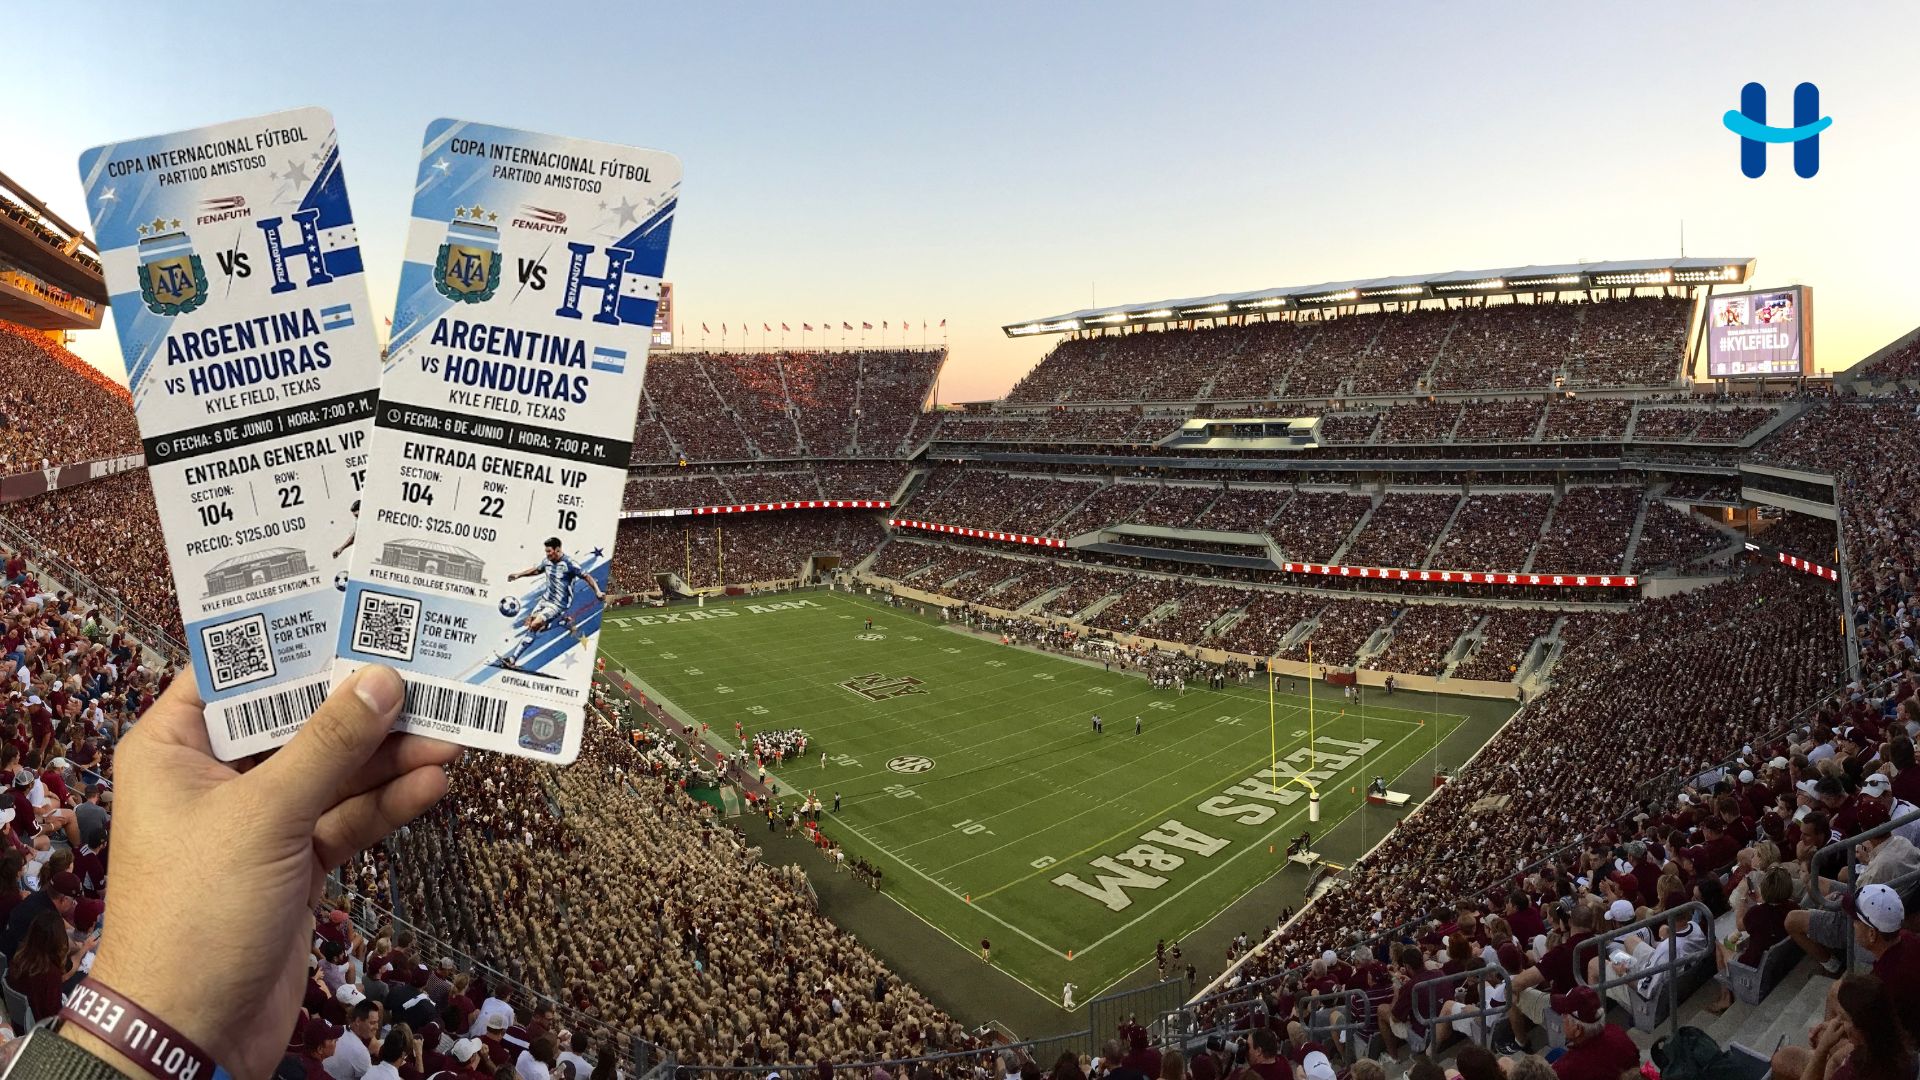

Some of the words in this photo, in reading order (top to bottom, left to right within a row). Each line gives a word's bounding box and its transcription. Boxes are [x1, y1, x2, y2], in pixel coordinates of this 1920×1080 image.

[108, 158, 142, 178] COPA
[148, 138, 253, 170] INTERNACIONAL
[256, 126, 308, 149] FÚTBOL
[451, 138, 486, 158] COPA
[490, 144, 595, 174] INTERNACIONAL
[600, 158, 651, 182] FÚTBOL
[159, 166, 207, 186] PARTIDO
[210, 156, 266, 177] AMISTOSO
[493, 166, 541, 184] PARTIDO
[544, 172, 602, 194] AMISTOSO
[197, 208, 250, 225] FENAFUTH
[512, 219, 568, 234] FENAFUTH
[168, 308, 320, 366] ARGENTINA
[431, 318, 586, 369] ARGENTINA
[1720, 333, 1789, 352] #KYLEFIELD
[164, 377, 185, 396] VS
[189, 341, 331, 396] HONDURAS
[421, 356, 439, 374] VS
[444, 356, 589, 403] HONDURAS
[205, 396, 238, 414] KYLE
[240, 386, 279, 406] FIELD,
[282, 378, 321, 398] TEXAS
[449, 390, 480, 407] KYLE
[484, 396, 521, 416] FIELD,
[527, 403, 566, 421] TEXAS
[287, 411, 319, 428] HORA:
[322, 405, 345, 420] 7:00
[404, 412, 442, 430] FECHA:
[444, 419, 451, 430] 6
[454, 421, 469, 435] DE
[470, 423, 504, 440] JUNIO
[174, 435, 212, 452] FECHA:
[224, 427, 239, 440] DE
[241, 420, 273, 436] JUNIO
[519, 430, 552, 448] HORA:
[555, 438, 579, 453] 7:00
[186, 456, 261, 486] ENTRADA
[264, 440, 336, 468] GENERAL
[338, 431, 365, 450] VIP
[404, 442, 477, 471] ENTRADA
[482, 456, 554, 484] GENERAL
[561, 469, 587, 489] VIP
[275, 471, 299, 484] ROW:
[401, 466, 442, 482] SECTION:
[191, 486, 235, 503] SECTION:
[278, 484, 304, 509] 22
[401, 482, 433, 505] 104
[484, 481, 507, 494] ROW:
[480, 496, 504, 518] 22
[558, 493, 584, 508] SEAT:
[198, 504, 233, 527] 104
[377, 509, 423, 529] PRECIO:
[426, 518, 469, 536] $125.00
[473, 527, 496, 542] USD
[557, 509, 577, 531] 16
[186, 535, 232, 556] PRECIO:
[236, 523, 280, 545] $125.00
[282, 517, 306, 533] USD
[479, 589, 488, 598] TX
[272, 614, 296, 631] SCAN
[299, 610, 314, 623] ME
[425, 610, 454, 626] SCAN
[456, 615, 468, 628] ME
[603, 608, 739, 629] TEXAS
[745, 599, 823, 615] A&M
[275, 628, 294, 644] FOR
[296, 621, 327, 638] ENTRY
[423, 625, 443, 639] FOR
[445, 629, 477, 644] ENTRY
[1197, 735, 1384, 826] TEXAS
[952, 819, 986, 836] 10
[1030, 856, 1057, 870] G
[1051, 818, 1232, 913] A&M
